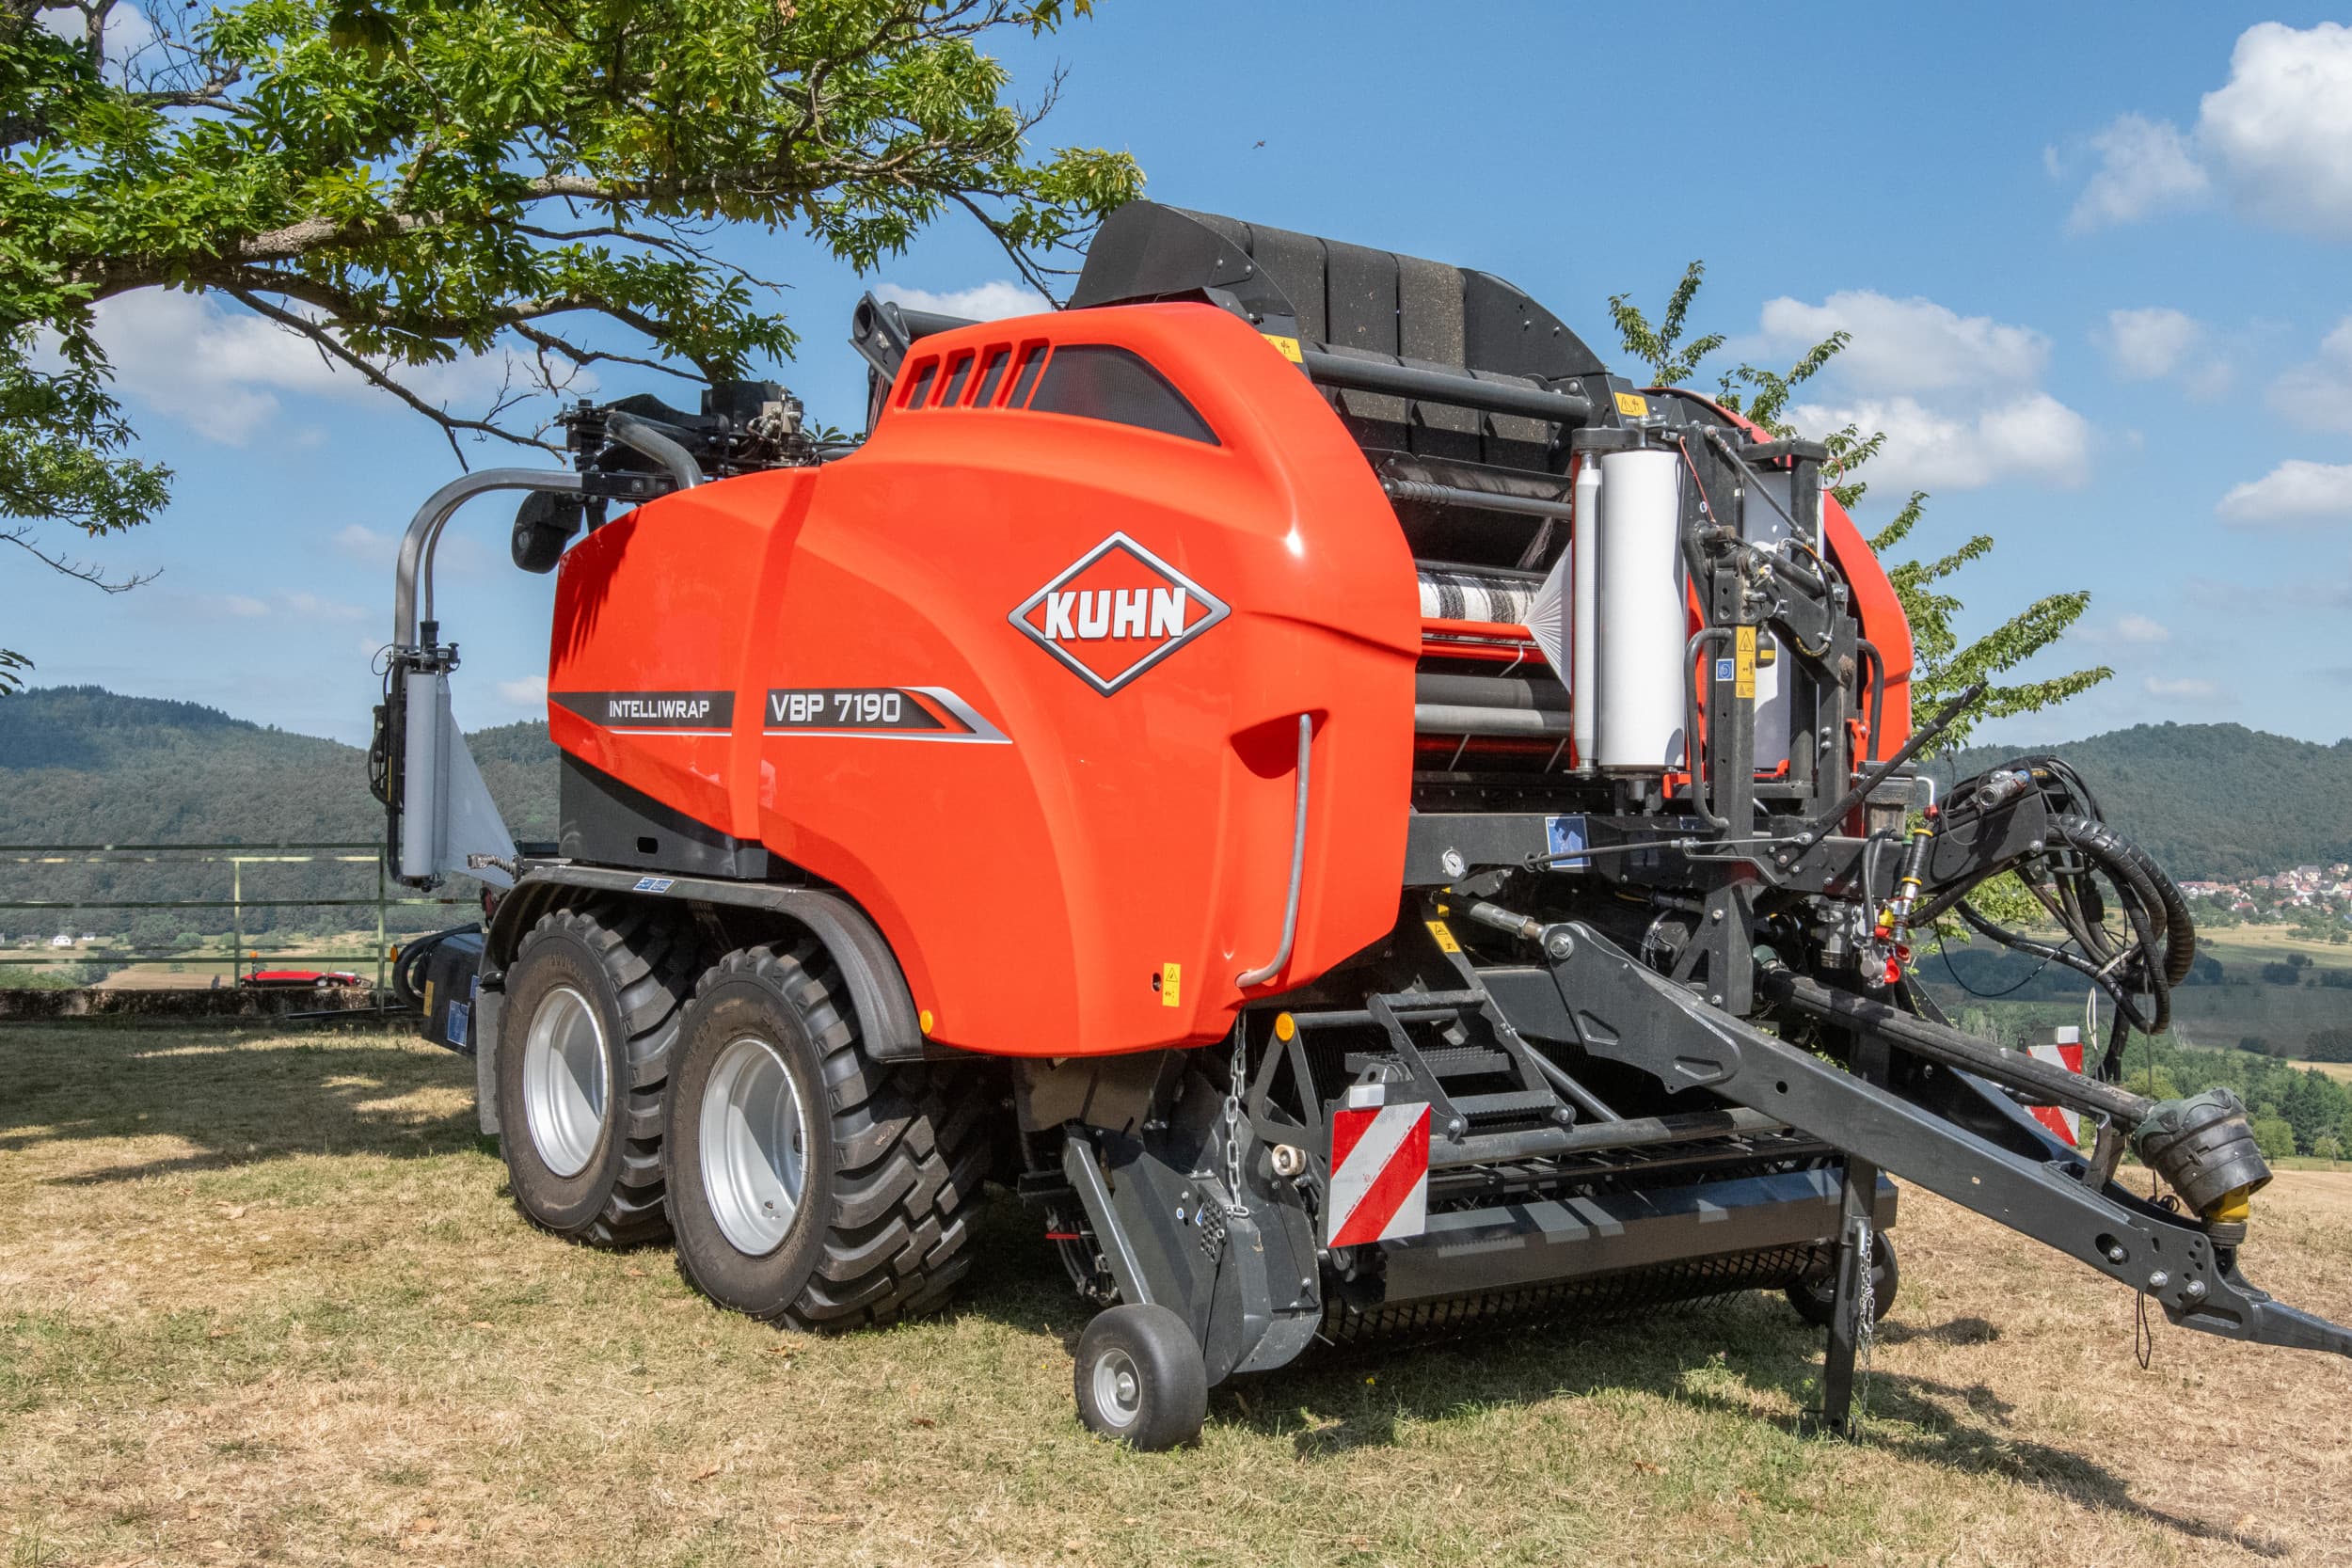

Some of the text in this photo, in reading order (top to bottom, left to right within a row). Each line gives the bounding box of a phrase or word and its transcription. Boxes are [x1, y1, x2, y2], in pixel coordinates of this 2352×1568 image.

[1044, 587, 1186, 639] KUHN
[610, 700, 709, 718] INTELLIWRAP
[771, 693, 901, 722] VBP 7190
